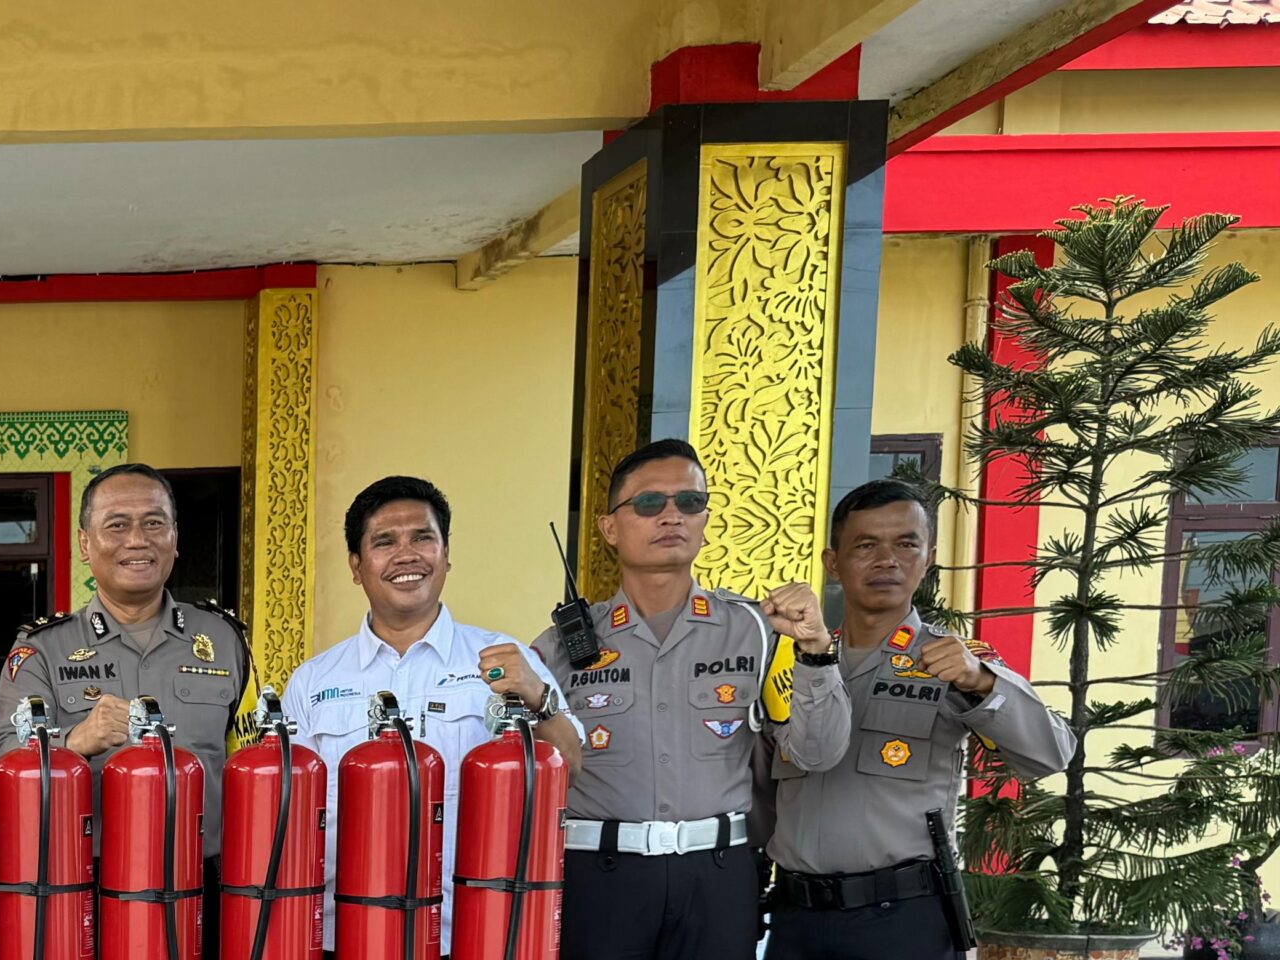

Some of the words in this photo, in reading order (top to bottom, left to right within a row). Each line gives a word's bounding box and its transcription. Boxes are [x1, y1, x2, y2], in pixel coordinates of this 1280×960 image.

[58, 665, 101, 681] IWAN
[104, 662, 116, 679] K
[570, 667, 630, 688] P.GULTOM
[694, 656, 754, 678] POLRI
[873, 681, 941, 702] POLRI
